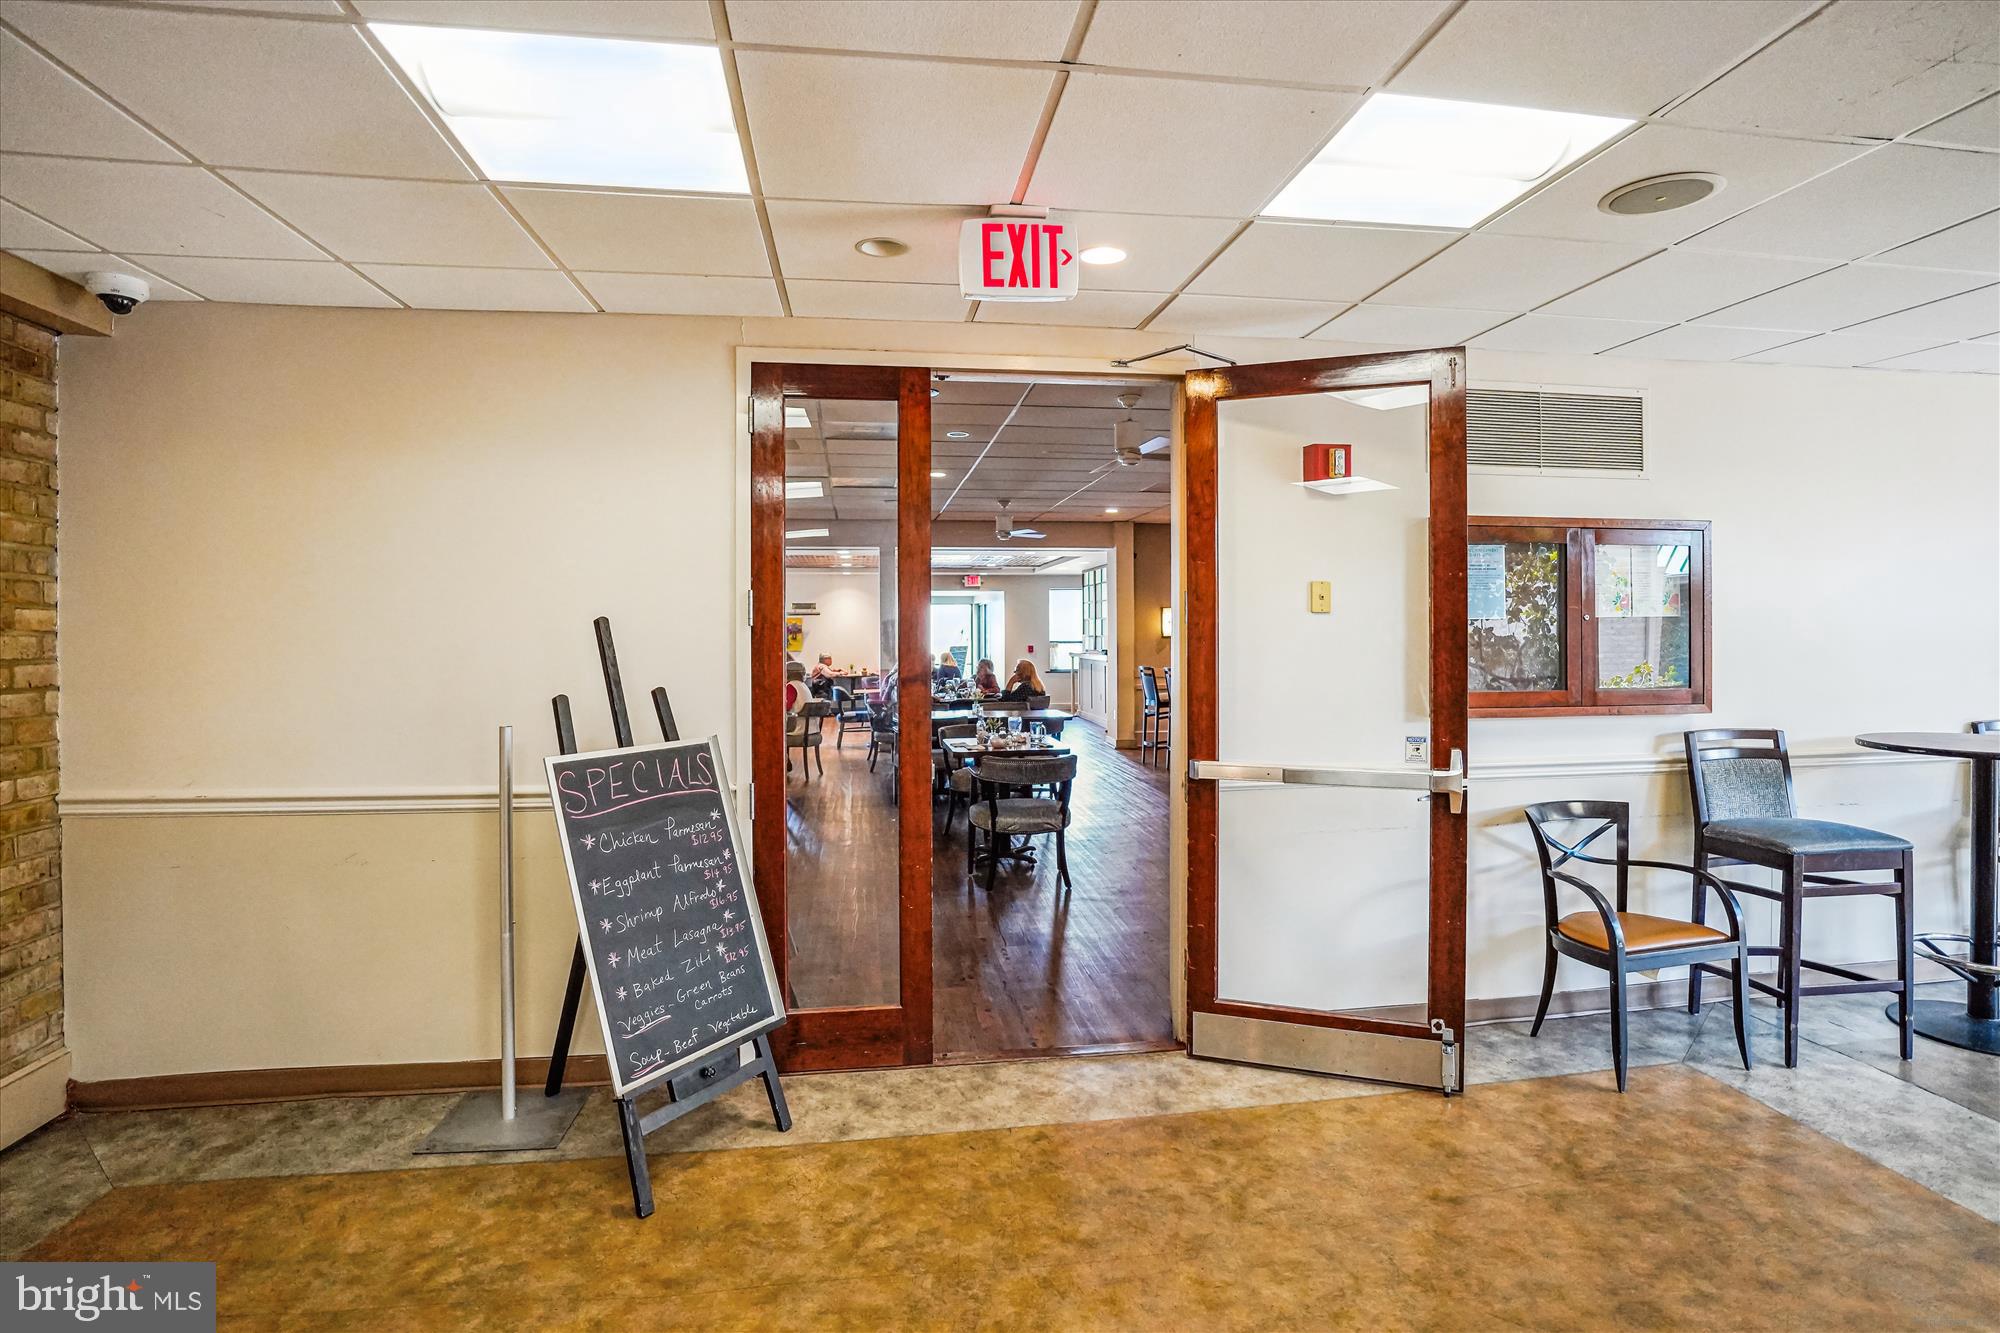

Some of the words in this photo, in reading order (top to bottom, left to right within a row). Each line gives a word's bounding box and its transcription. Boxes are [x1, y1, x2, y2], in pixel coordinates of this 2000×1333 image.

[981, 223, 1064, 289] EXIT
[558, 752, 713, 813] SPECIALS
[599, 832, 659, 853] Chicken
[664, 816, 717, 841] Parmesan
[602, 861, 662, 898] Eggplant
[668, 854, 724, 874] Parmesan
[616, 906, 664, 934] Shrimp
[709, 890, 739, 910] $16.95
[627, 934, 664, 967] Meat
[673, 922, 724, 948] Lasagna
[632, 969, 675, 999] Baked
[680, 949, 712, 974] Ziti
[676, 979, 714, 1004] Green
[718, 964, 746, 984] Beans
[673, 1028, 699, 1055] Beef
[707, 1004, 758, 1034] Vegetable
